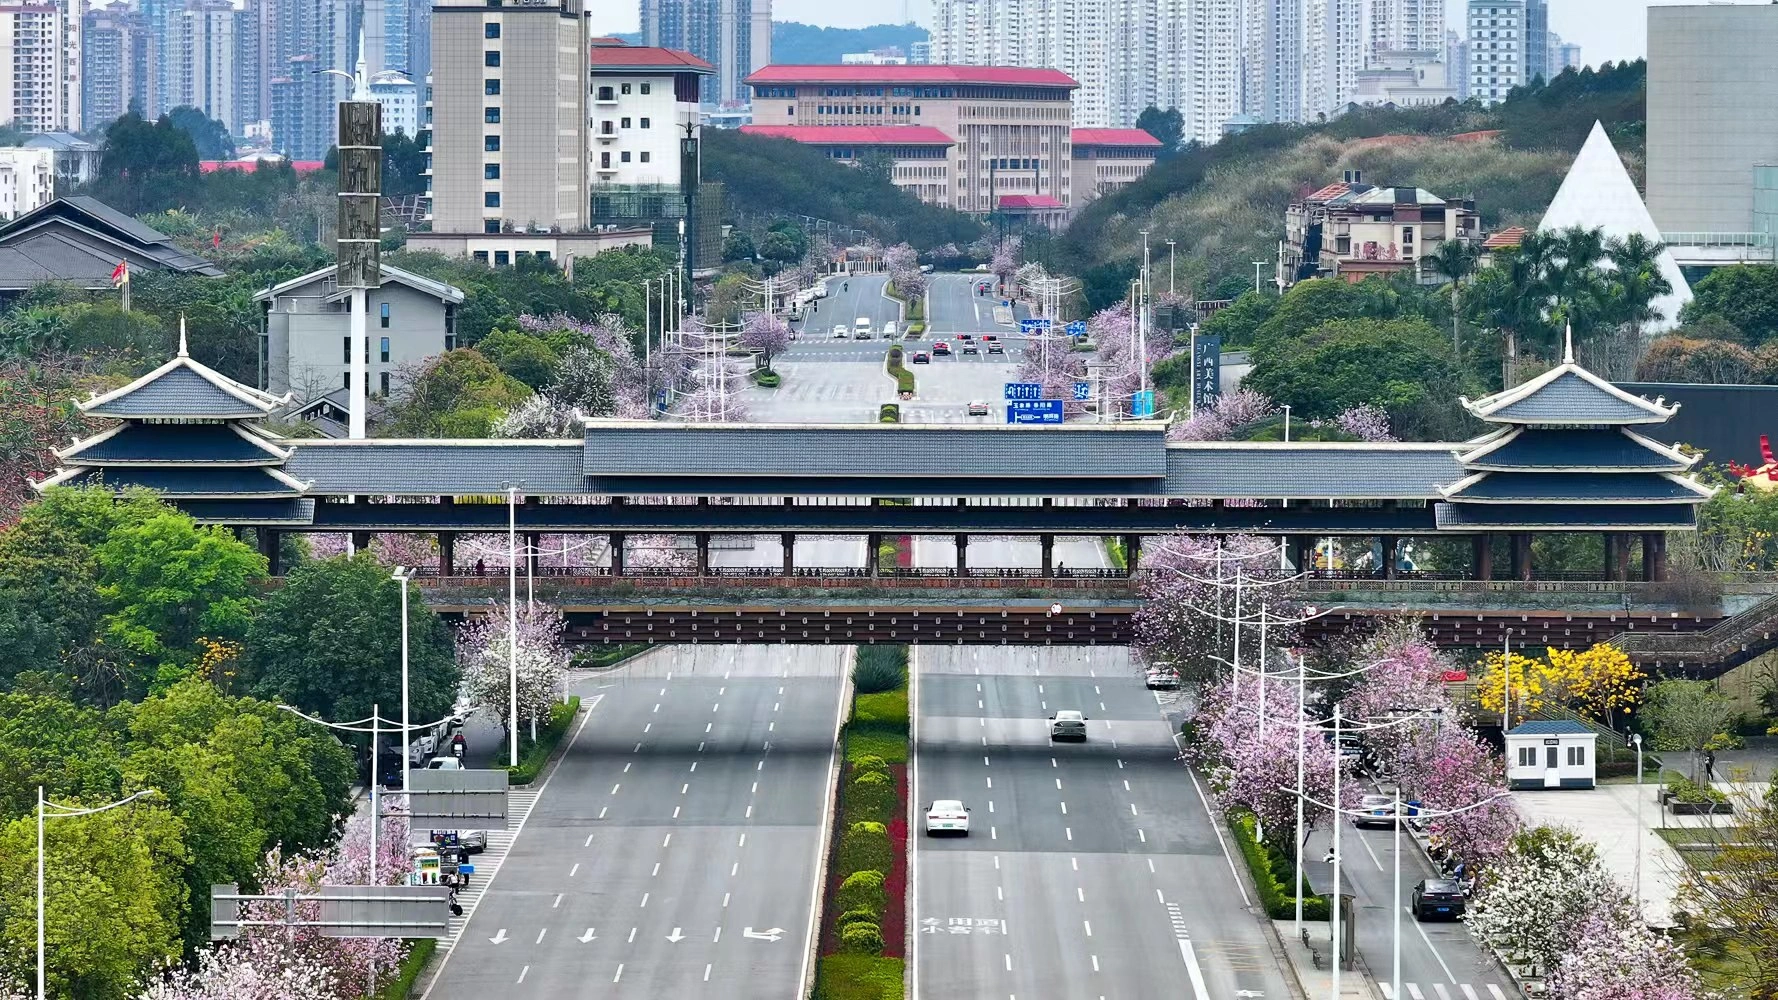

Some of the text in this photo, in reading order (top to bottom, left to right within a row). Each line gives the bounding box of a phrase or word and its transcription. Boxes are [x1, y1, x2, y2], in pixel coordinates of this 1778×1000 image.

[1203, 342, 1214, 404] 广西美术馆
